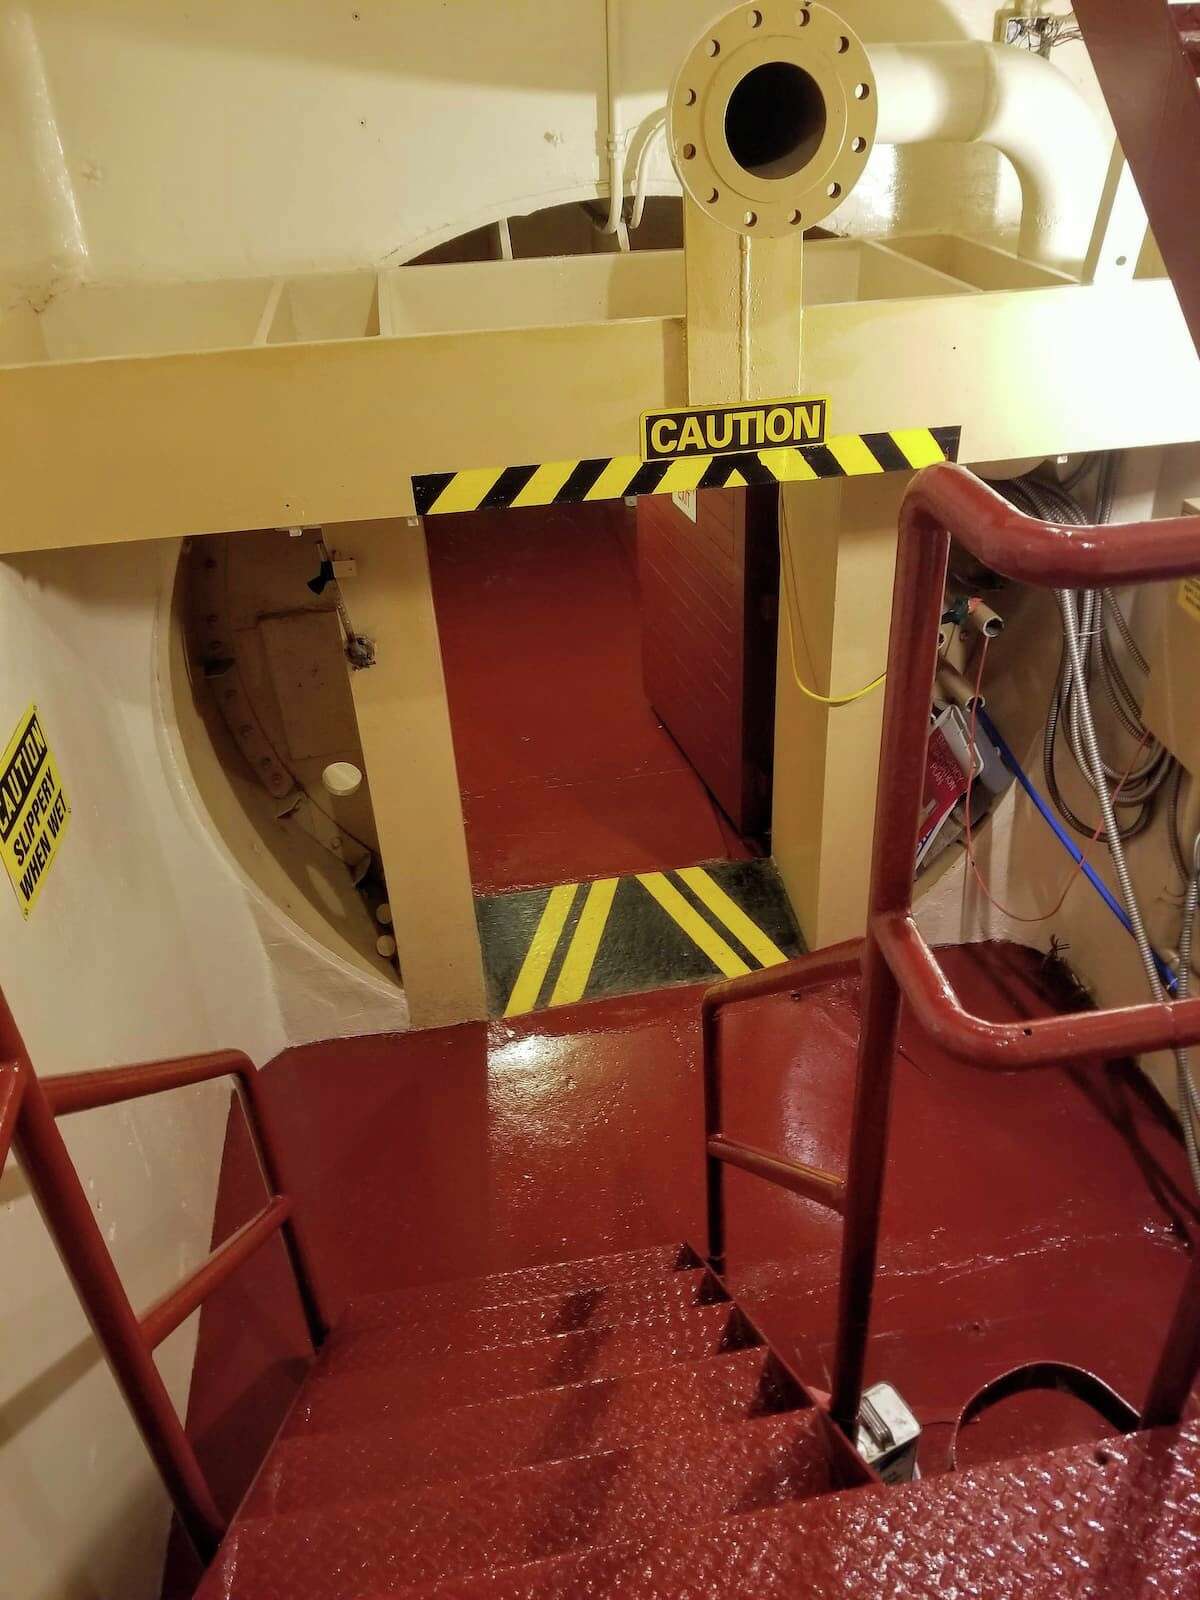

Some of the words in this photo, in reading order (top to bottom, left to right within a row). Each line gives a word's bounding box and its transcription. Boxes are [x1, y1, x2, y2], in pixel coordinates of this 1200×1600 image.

[651, 405, 820, 453] CAUTION
[13, 765, 56, 866] SLIPPERY
[19, 830, 51, 901] WHEN
[47, 788, 67, 839] WET
